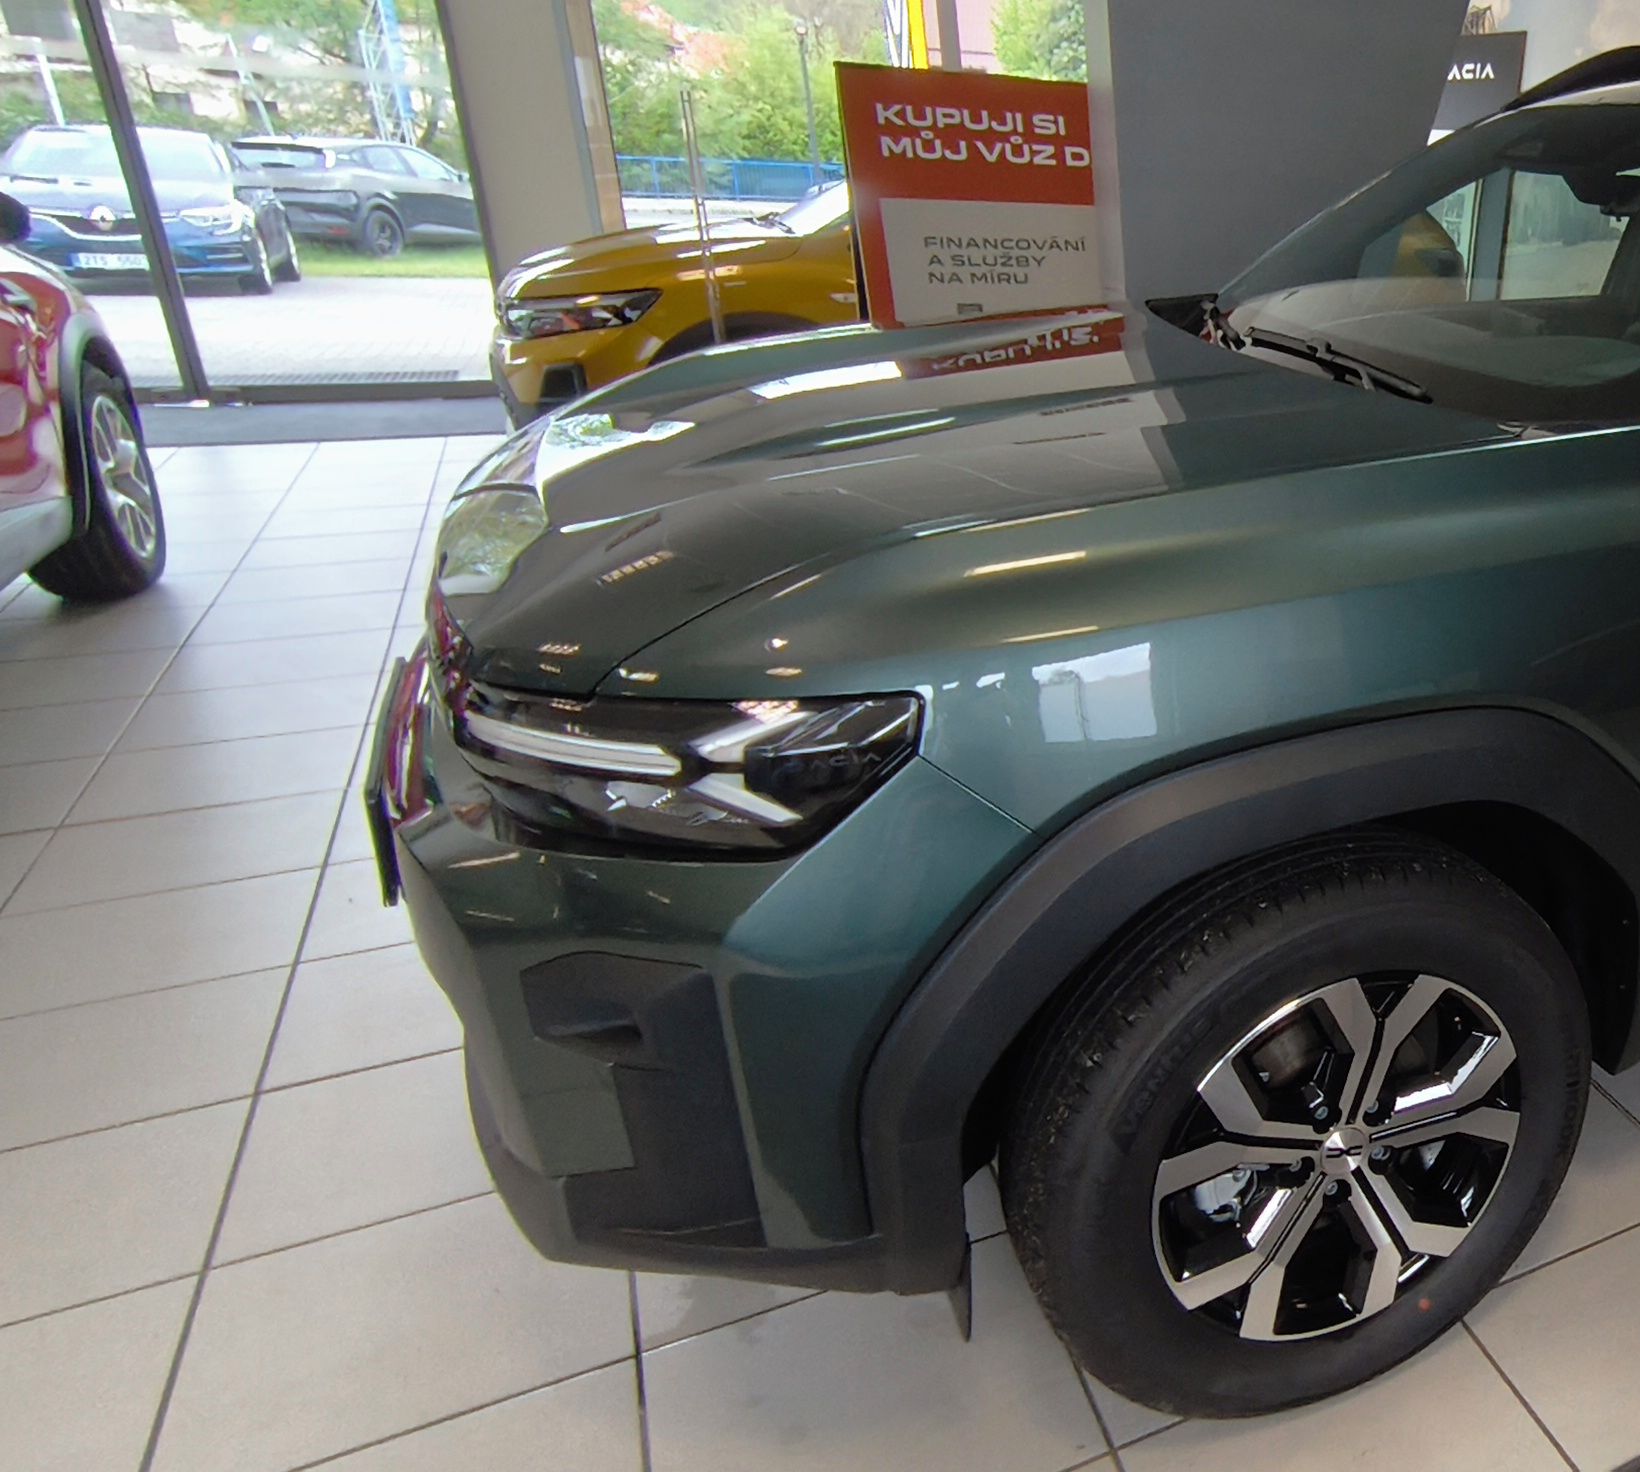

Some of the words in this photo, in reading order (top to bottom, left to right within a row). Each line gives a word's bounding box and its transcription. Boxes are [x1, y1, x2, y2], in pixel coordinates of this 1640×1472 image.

[1447, 63, 1495, 80] ACIA
[875, 102, 1024, 133] KUPUJI
[1032, 113, 1066, 136] SI
[880, 130, 968, 161] MŮJ
[974, 135, 1057, 166] VŮZ
[1064, 145, 1091, 167] D
[924, 235, 1087, 252] FINANCOVÁNÍ
[928, 254, 943, 267] A
[951, 251, 1047, 268] SLUŽBY
[928, 271, 964, 285] NA
[970, 269, 1029, 285] MÍRU
